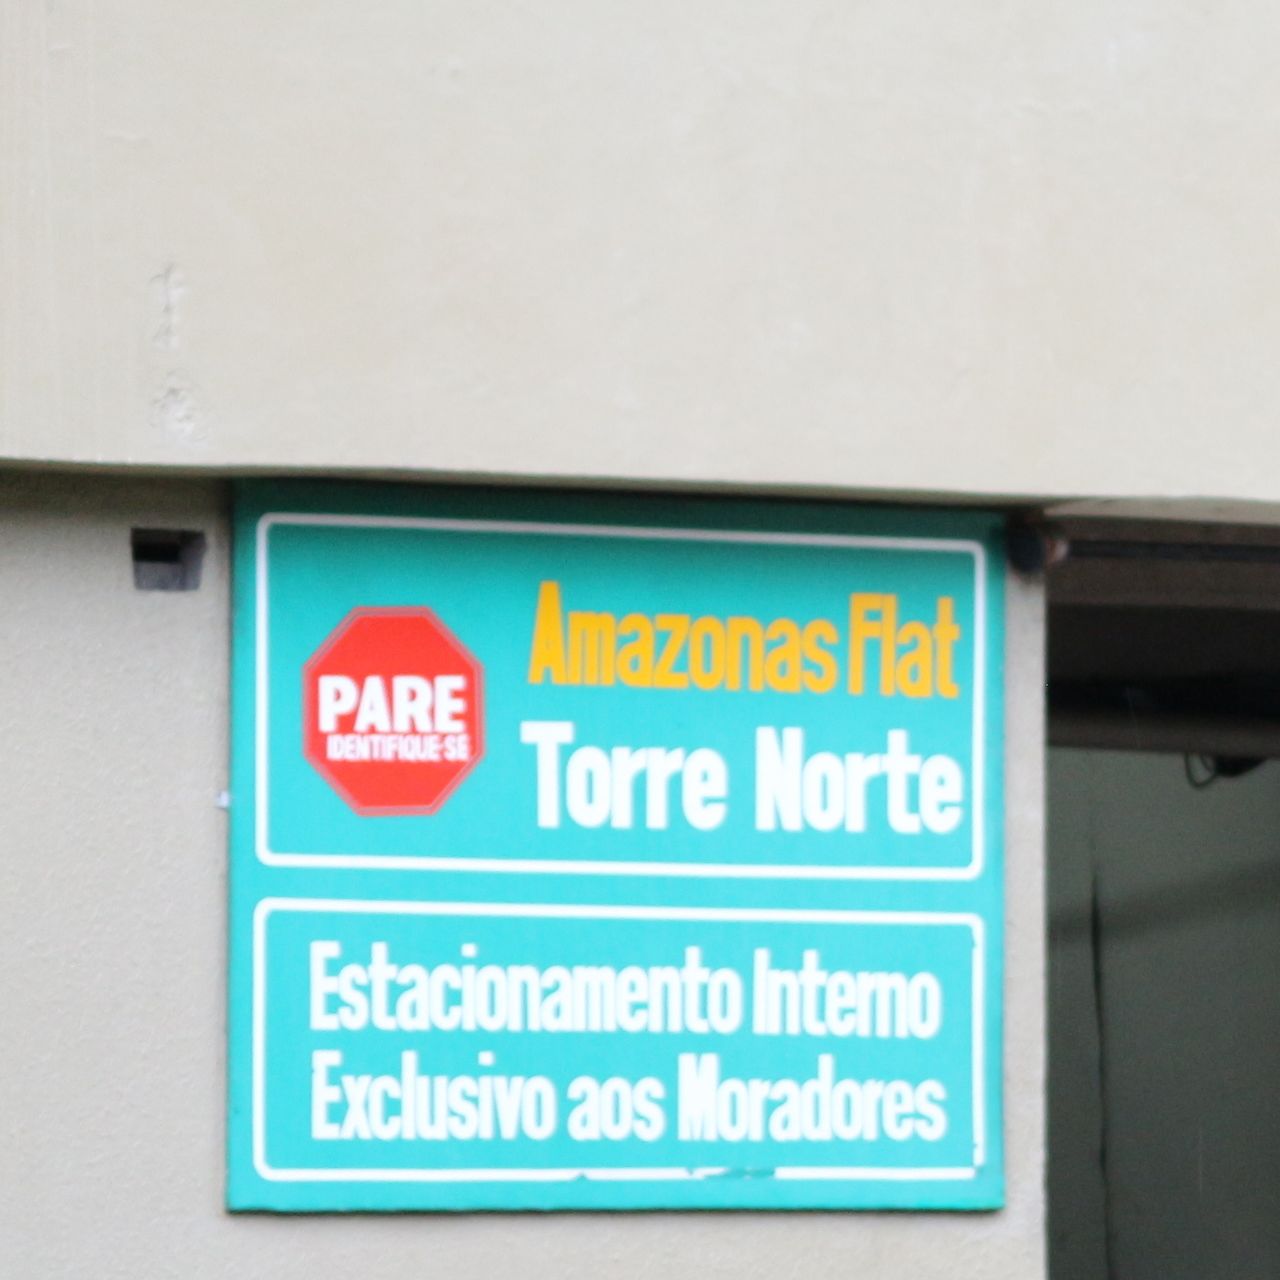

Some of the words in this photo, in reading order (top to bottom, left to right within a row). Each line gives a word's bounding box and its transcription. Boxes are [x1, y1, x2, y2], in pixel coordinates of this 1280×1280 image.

[529, 581, 838, 693] Amazonas
[847, 593, 961, 698] Flat
[318, 675, 467, 734] PARE
[326, 734, 471, 763] IDENTIFIQUE-SE
[520, 721, 729, 830] Torre
[755, 726, 964, 834] Norte
[310, 940, 744, 1034] Estacionamento
[752, 948, 942, 1039] Interno
[311, 1049, 557, 1140] Exclusivo
[567, 1076, 666, 1142] aos
[678, 1052, 948, 1142] Moradores
